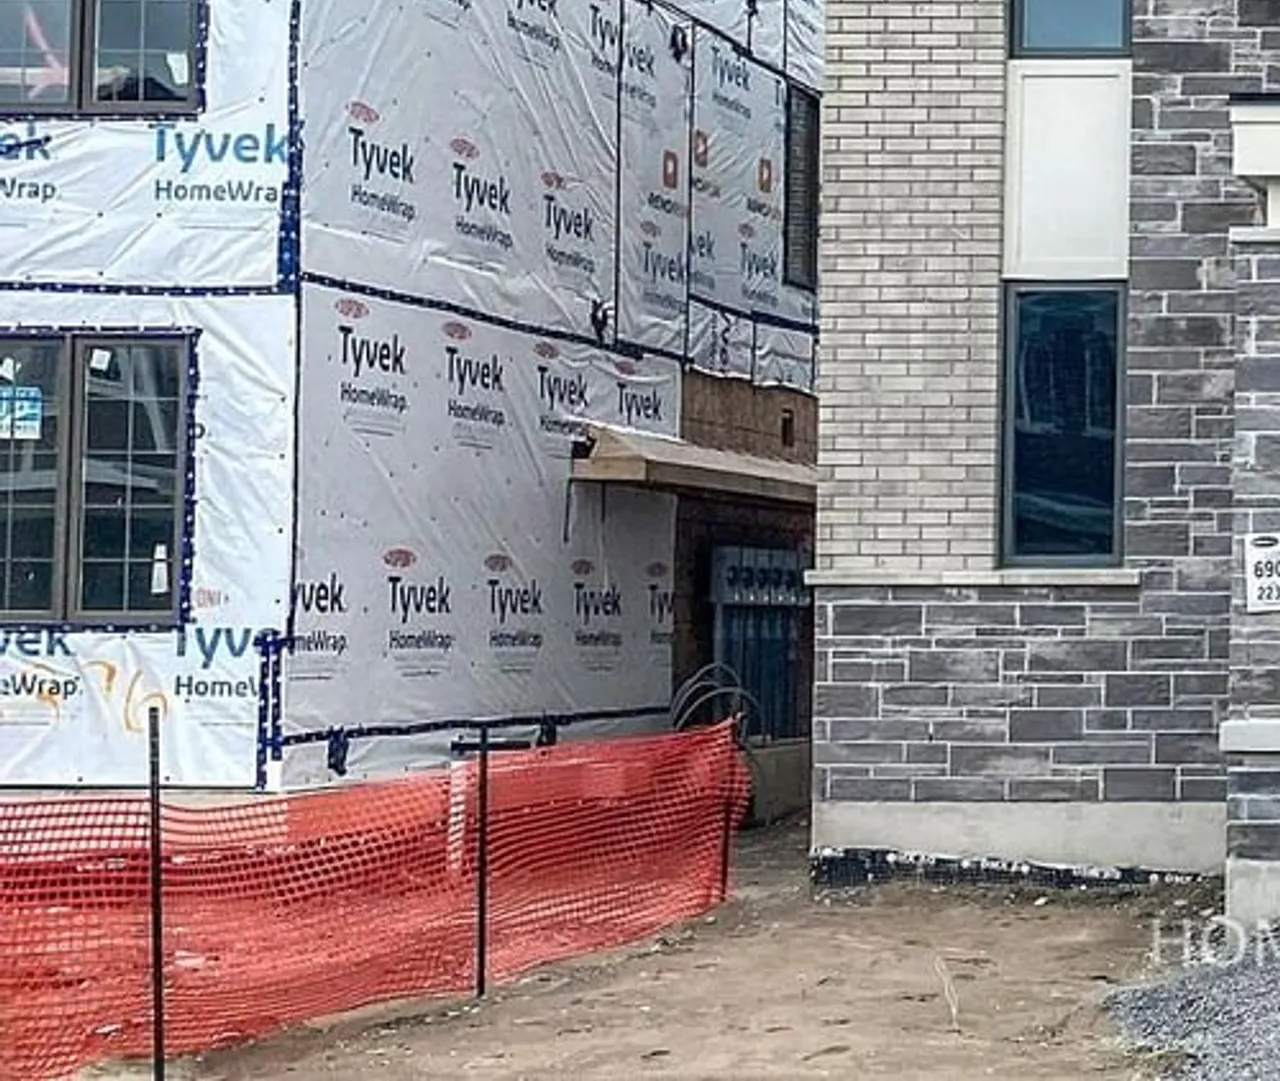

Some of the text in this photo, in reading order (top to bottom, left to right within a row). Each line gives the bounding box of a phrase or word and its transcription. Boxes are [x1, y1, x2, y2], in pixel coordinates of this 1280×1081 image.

[148, 122, 288, 173] Tyvek
[348, 126, 414, 184] Tyvek
[155, 179, 278, 201] HomeWra
[453, 161, 511, 215] Tyvek
[543, 193, 594, 242] Tyvek
[338, 325, 406, 378] Tyvek
[445, 345, 504, 396] Tyvek
[340, 381, 408, 414] HomeWrap
[537, 365, 589, 411] Tyvek
[617, 382, 662, 426] Tyvek
[297, 572, 344, 613] vek
[388, 575, 451, 624] Tyvek
[488, 578, 542, 624] Tyvek
[573, 582, 621, 626] Tyvek
[648, 583, 676, 623] Tyv
[389, 630, 453, 653] HomeWrap
